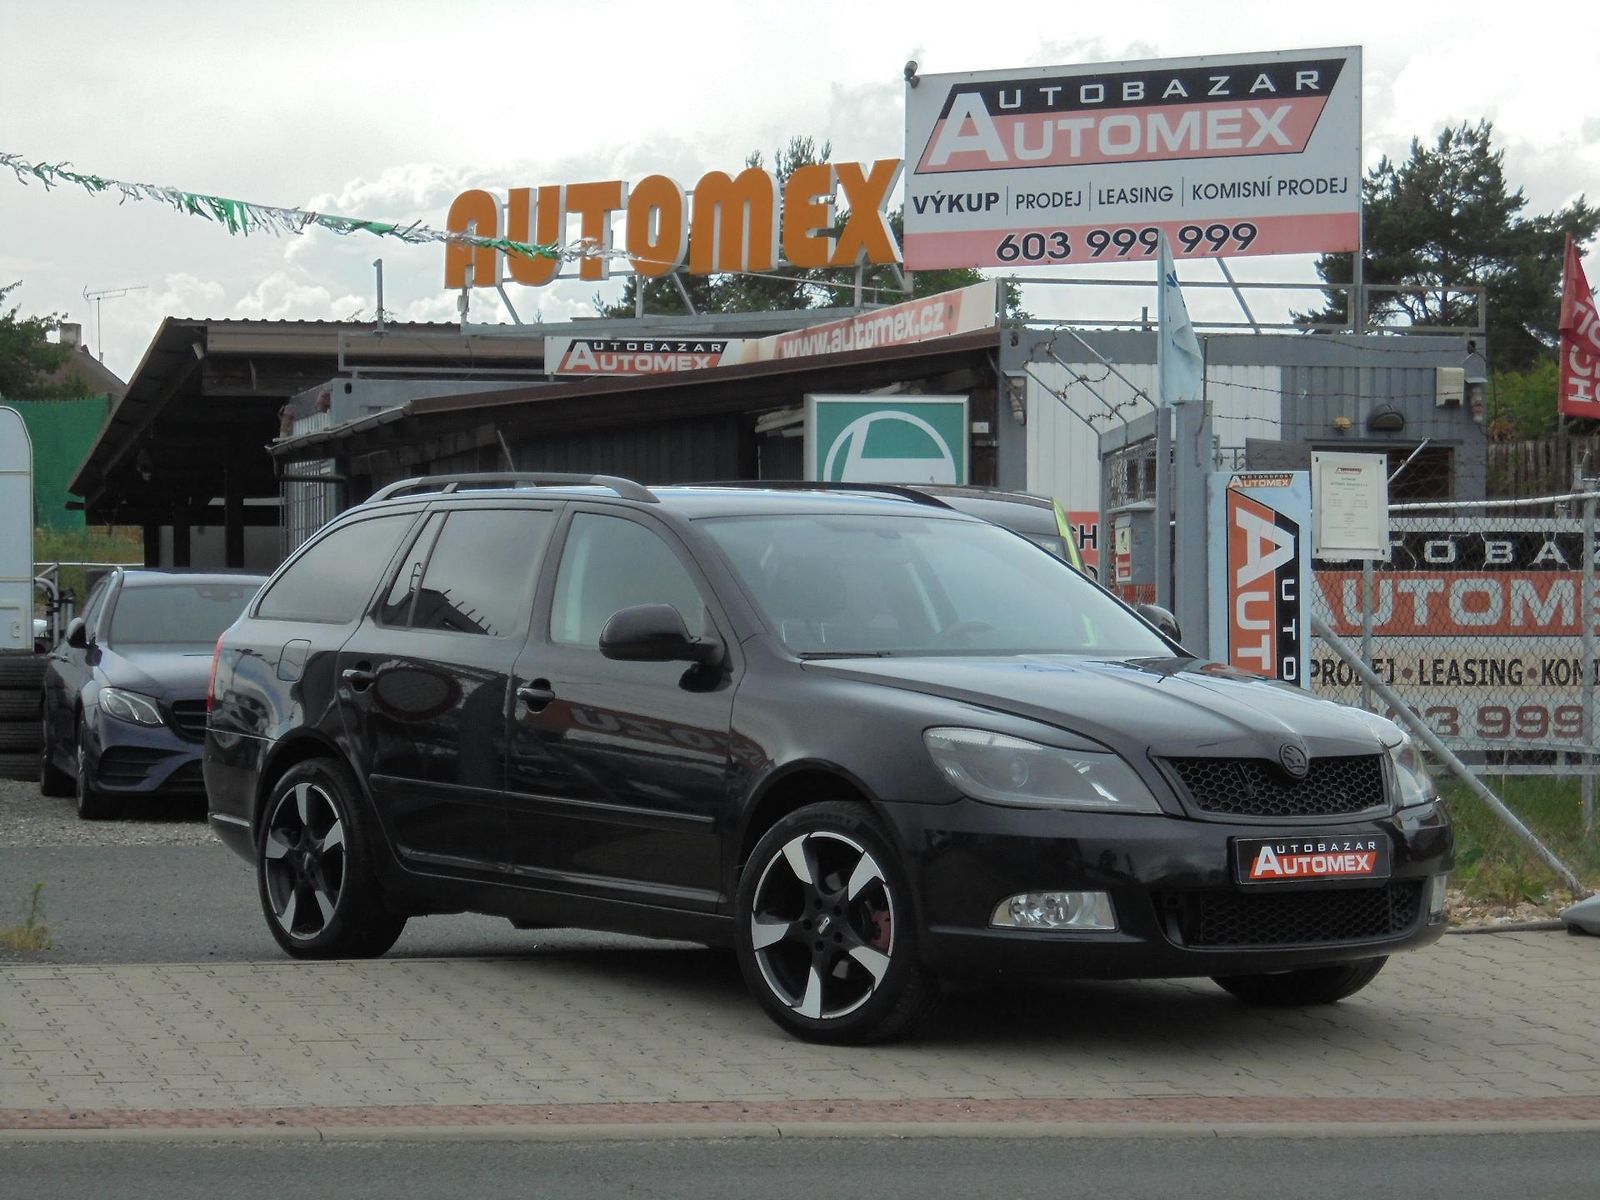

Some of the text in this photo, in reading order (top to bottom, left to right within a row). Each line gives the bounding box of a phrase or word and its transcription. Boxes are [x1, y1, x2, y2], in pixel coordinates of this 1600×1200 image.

[927, 92, 1293, 166] AUTOMEX
[912, 176, 1348, 215] VÝKUP PRODEJ LEASING KOMISNÍ PRODEJ
[444, 158, 904, 289] AUTOMEX
[996, 222, 1258, 262] 603 999 999
[783, 302, 945, 358] www.automex.cz
[564, 342, 712, 372] AUTOMEX
[1228, 475, 1289, 488] AUTOMEX
[1419, 659, 1523, 686] LEASING
[1477, 706, 1584, 739] 999
[1254, 846, 1370, 876] AUTOMEX
